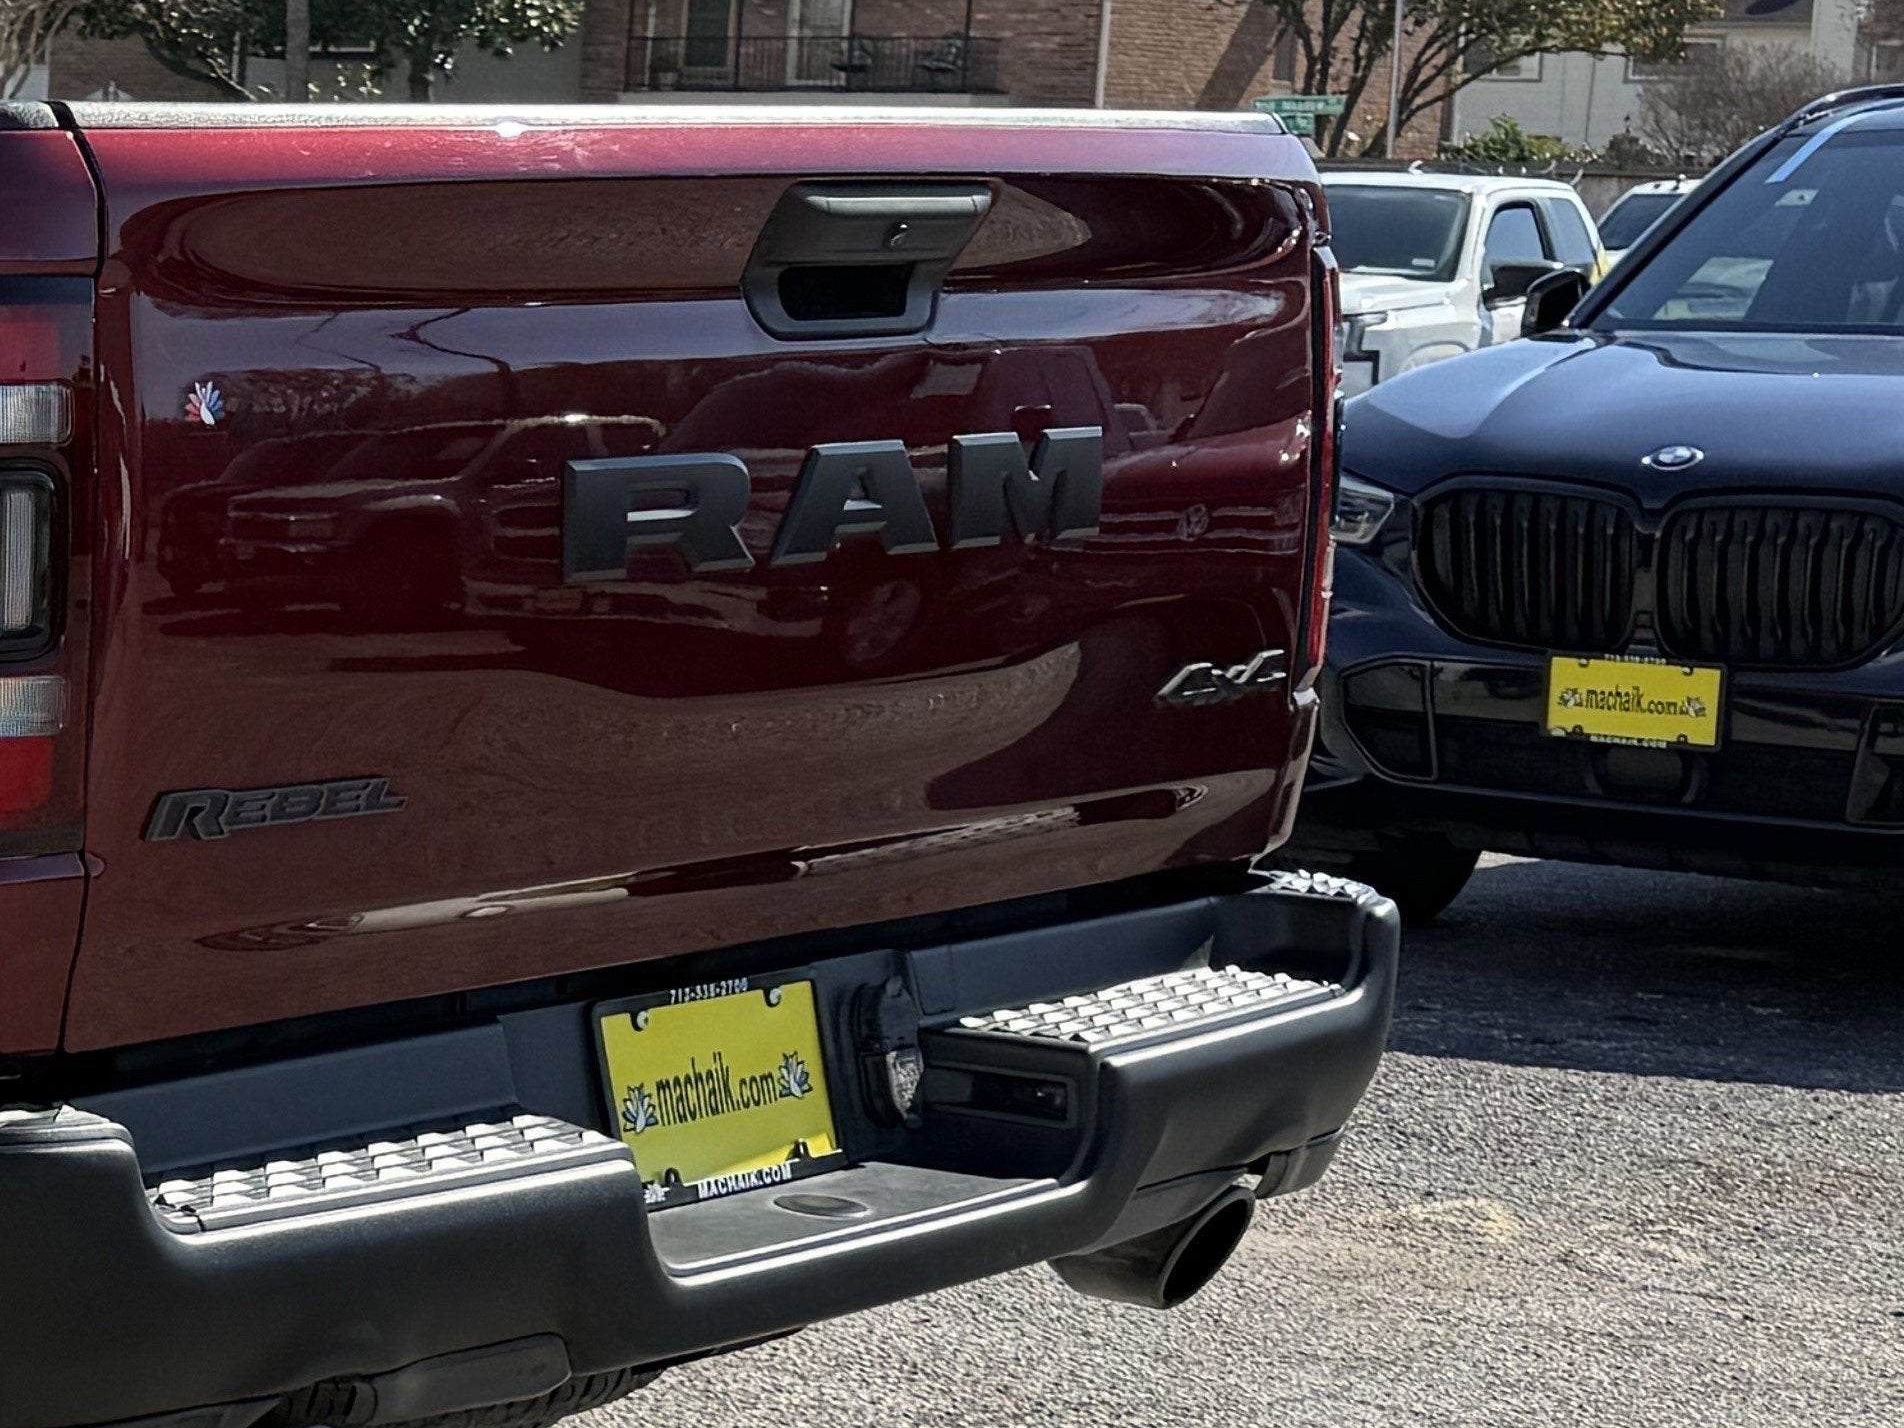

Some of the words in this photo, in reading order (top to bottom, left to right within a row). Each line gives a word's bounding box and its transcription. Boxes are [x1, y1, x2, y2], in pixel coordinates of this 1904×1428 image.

[563, 425, 1103, 582] RAM
[143, 775, 409, 842] REBEL
[656, 1051, 778, 1127] machaik.com
